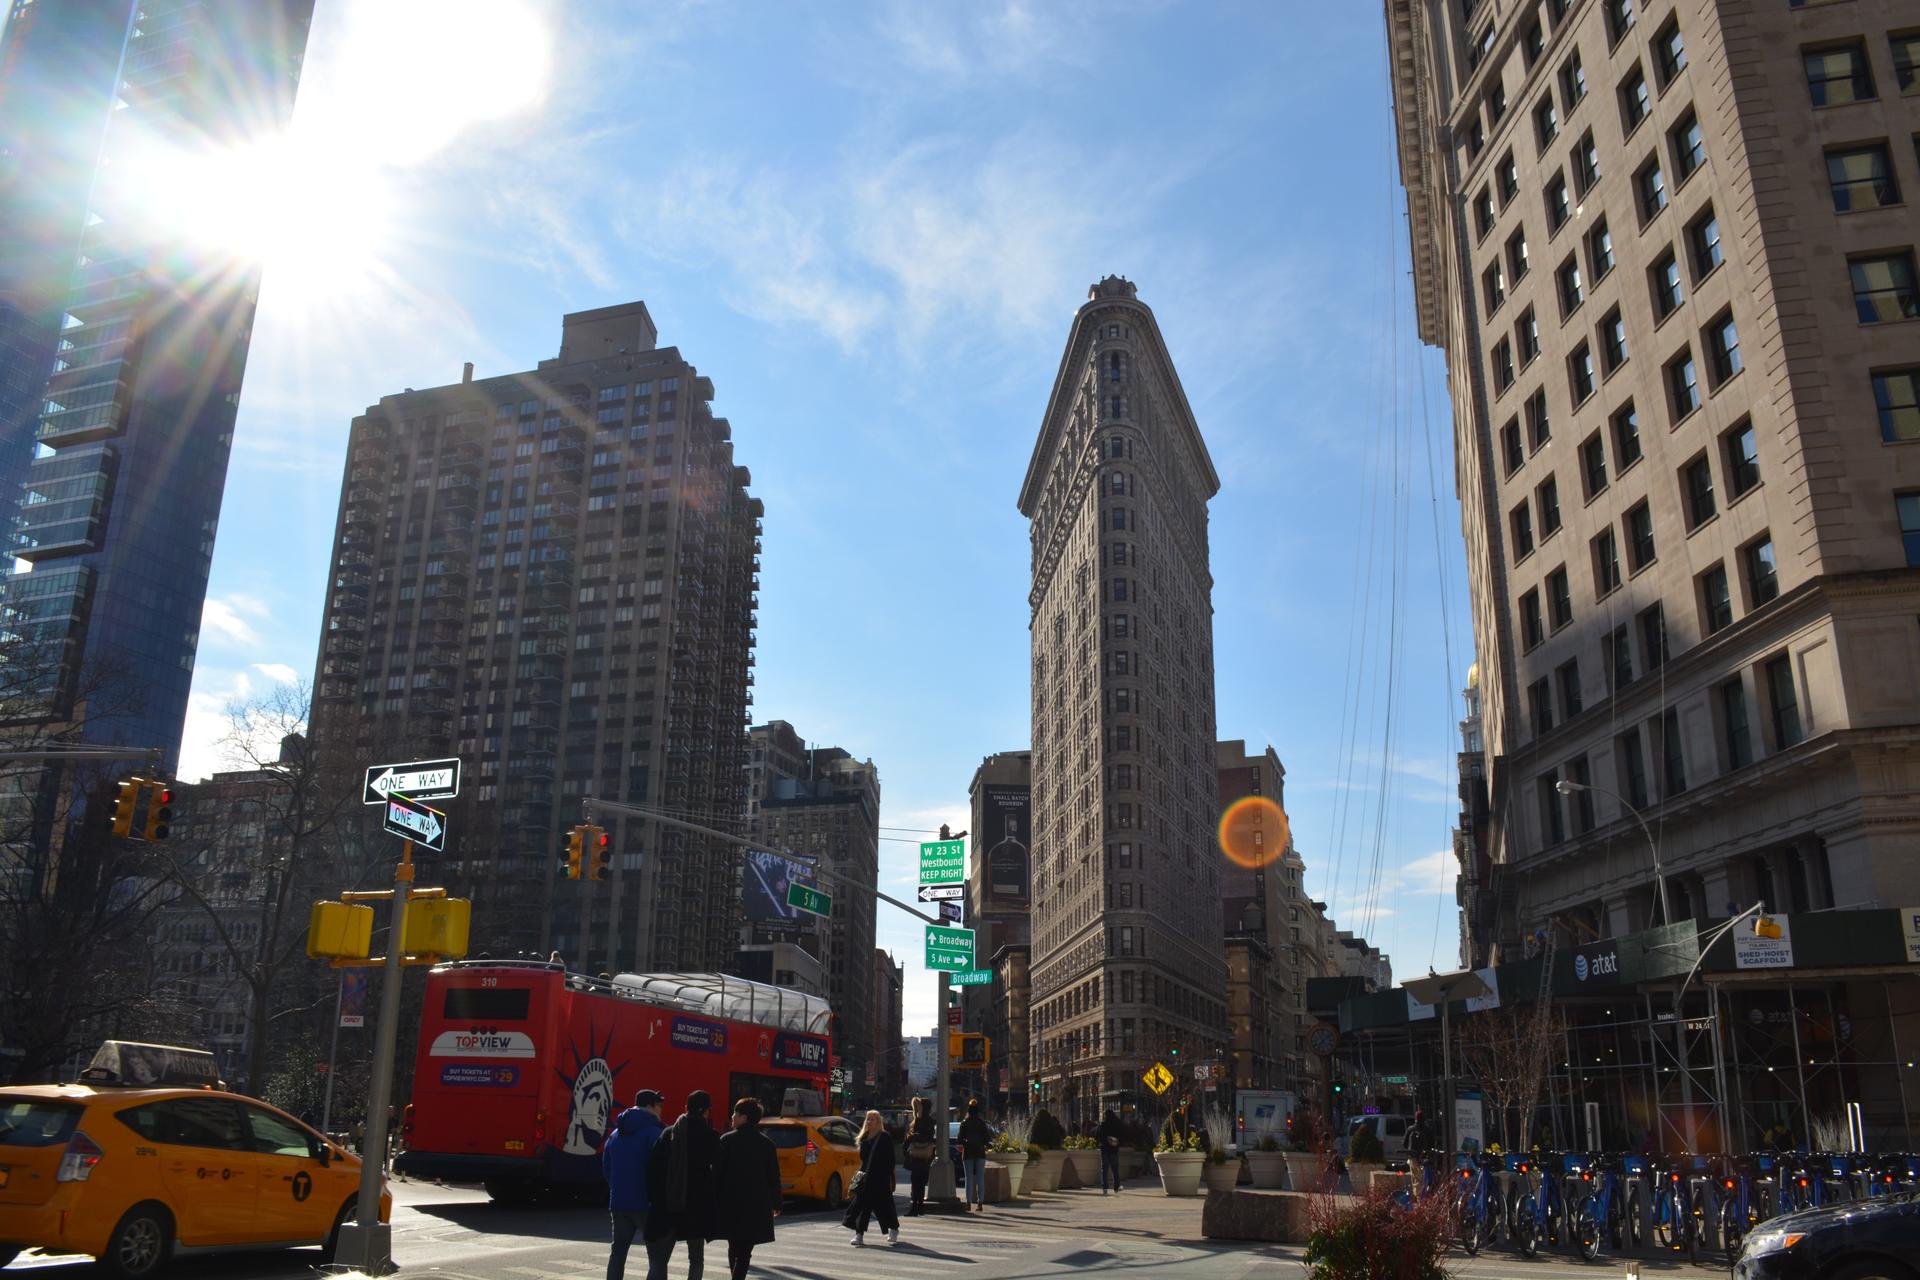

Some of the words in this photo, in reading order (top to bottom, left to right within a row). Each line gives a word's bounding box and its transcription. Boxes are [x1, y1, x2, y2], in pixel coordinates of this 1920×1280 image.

[380, 775, 406, 790] ONE
[418, 771, 446, 787] WAY
[394, 807, 412, 827] ONE
[419, 820, 437, 836] WAY
[924, 847, 932, 856] W
[936, 846, 947, 855] 23
[951, 845, 960, 855] St
[921, 857, 963, 869] Westbound
[921, 870, 939, 880] KEEP
[941, 868, 962, 879] RIGHT
[803, 892, 809, 906] 5
[922, 890, 938, 898] ONE
[946, 888, 960, 896] WAY
[939, 934, 973, 949] Broadway
[931, 954, 936, 963] 5
[938, 954, 951, 964] Ave
[1592, 951, 1618, 976] at&t
[1743, 957, 1787, 965] SCAFFOLD
[953, 972, 988, 984] Broadway
